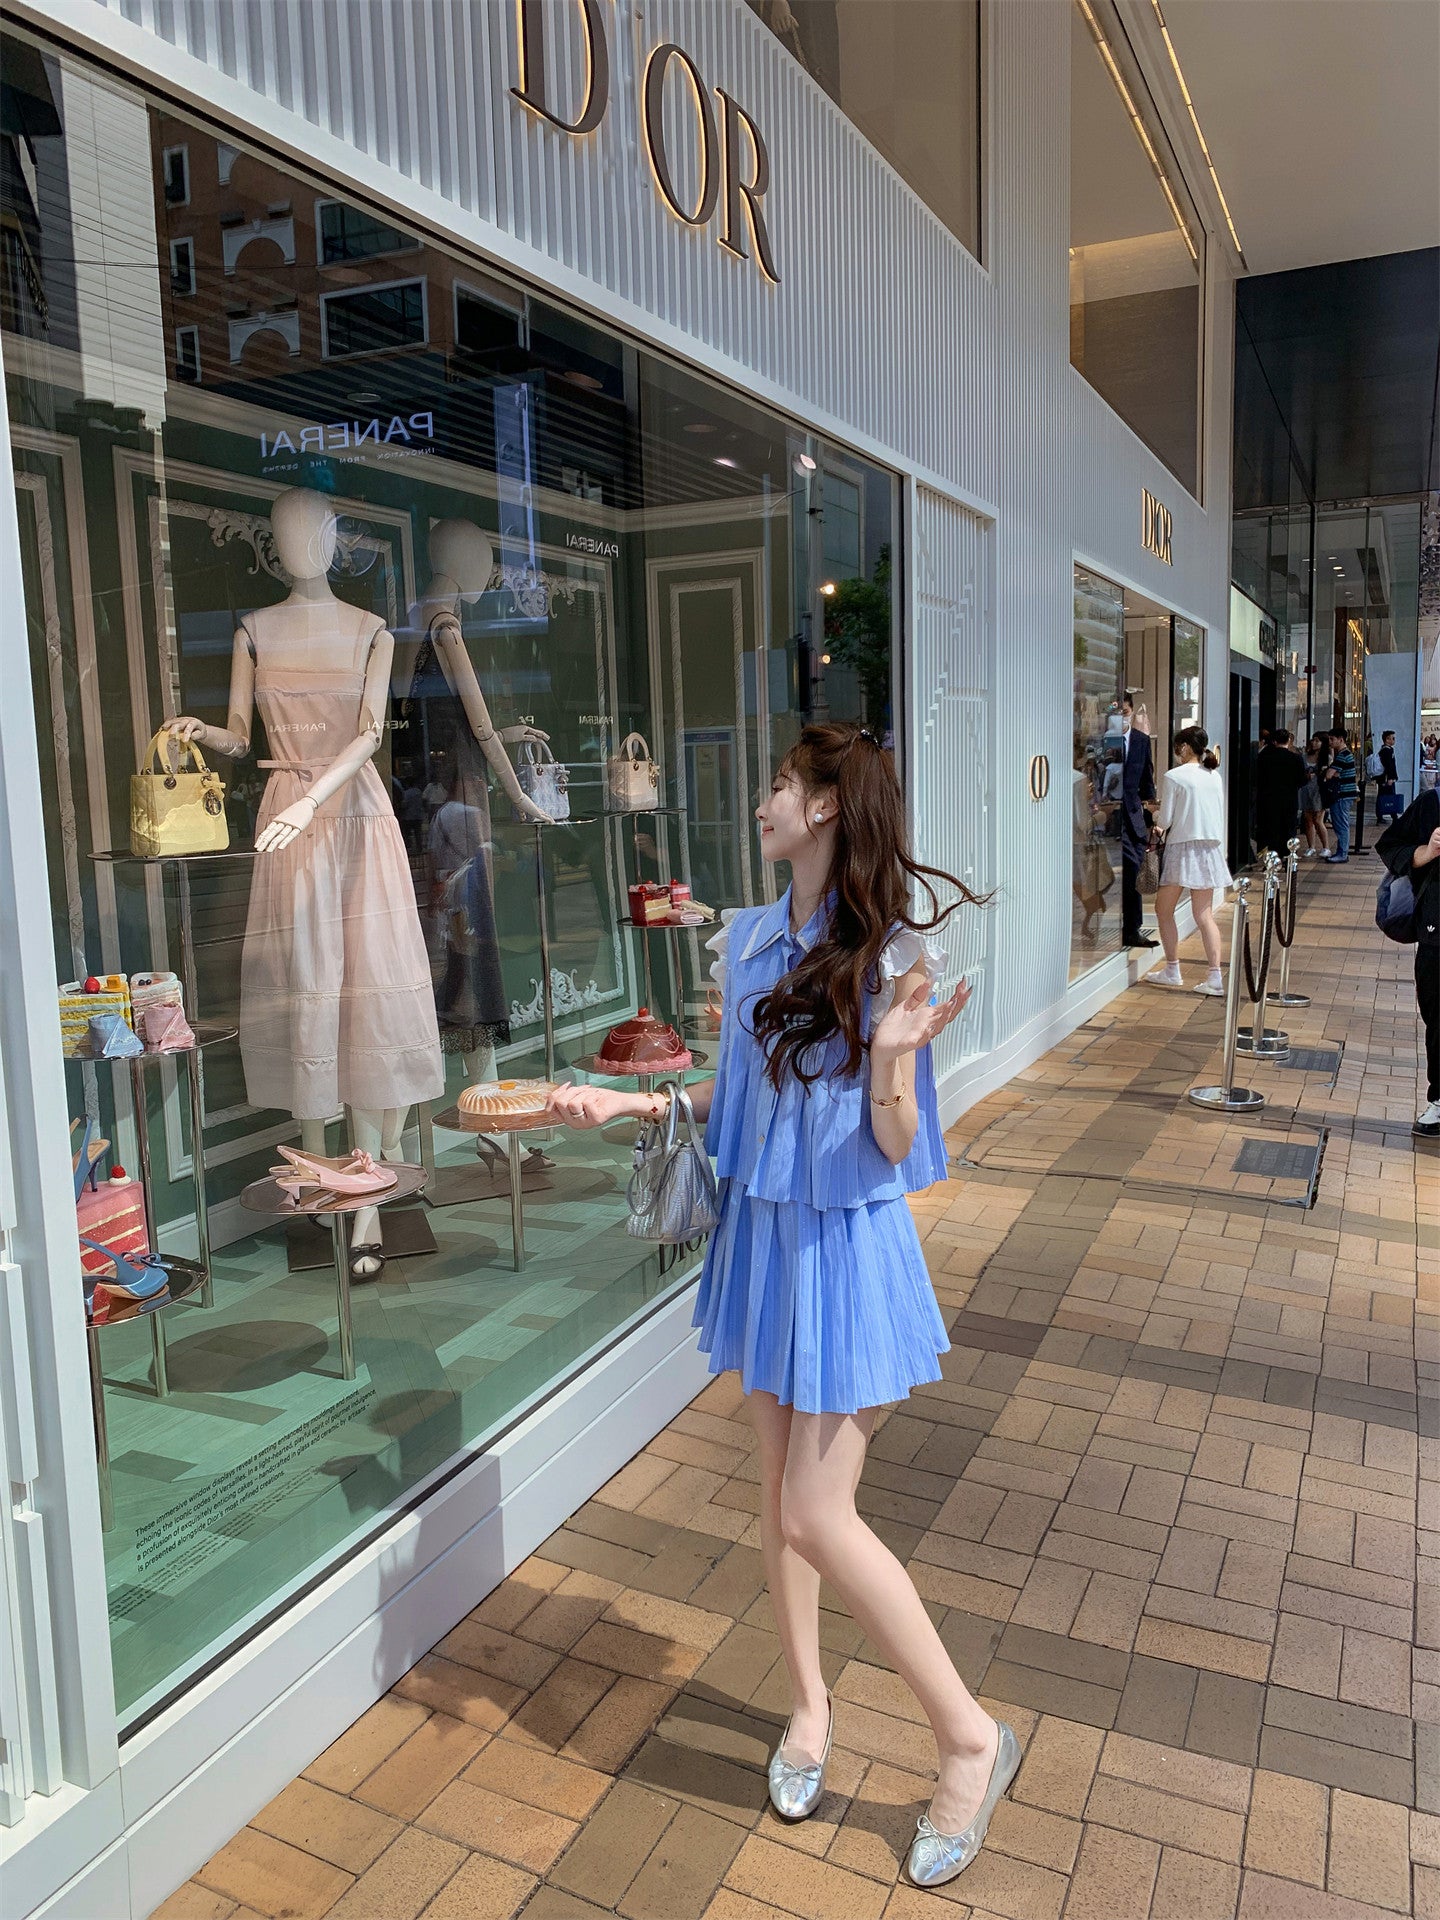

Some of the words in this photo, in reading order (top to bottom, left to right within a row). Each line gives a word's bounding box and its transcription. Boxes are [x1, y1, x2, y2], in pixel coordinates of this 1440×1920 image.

[510, 0, 782, 283] DOR
[1141, 488, 1174, 567] DIOR
[135, 1521, 155, 1537] These
[156, 1500, 188, 1524] immersive
[189, 1485, 211, 1502] window
[212, 1469, 236, 1489] displays
[236, 1456, 253, 1472] reveal
[336, 1398, 345, 1408] and
[142, 1534, 172, 1559] profusion
[181, 1506, 212, 1531] exquisitely
[213, 1491, 236, 1509] enticing
[237, 1480, 253, 1494] cakes
[259, 1454, 290, 1479] handcrafted
[297, 1443, 310, 1456] glass
[311, 1435, 320, 1445] and
[136, 1529, 161, 1549] echoing
[162, 1521, 173, 1531] the
[174, 1509, 192, 1524] iconic
[193, 1497, 211, 1511] codes
[145, 1541, 176, 1570] presented
[177, 1523, 206, 1546] alongside
[225, 1500, 239, 1513] most
[239, 1485, 259, 1504] refined
